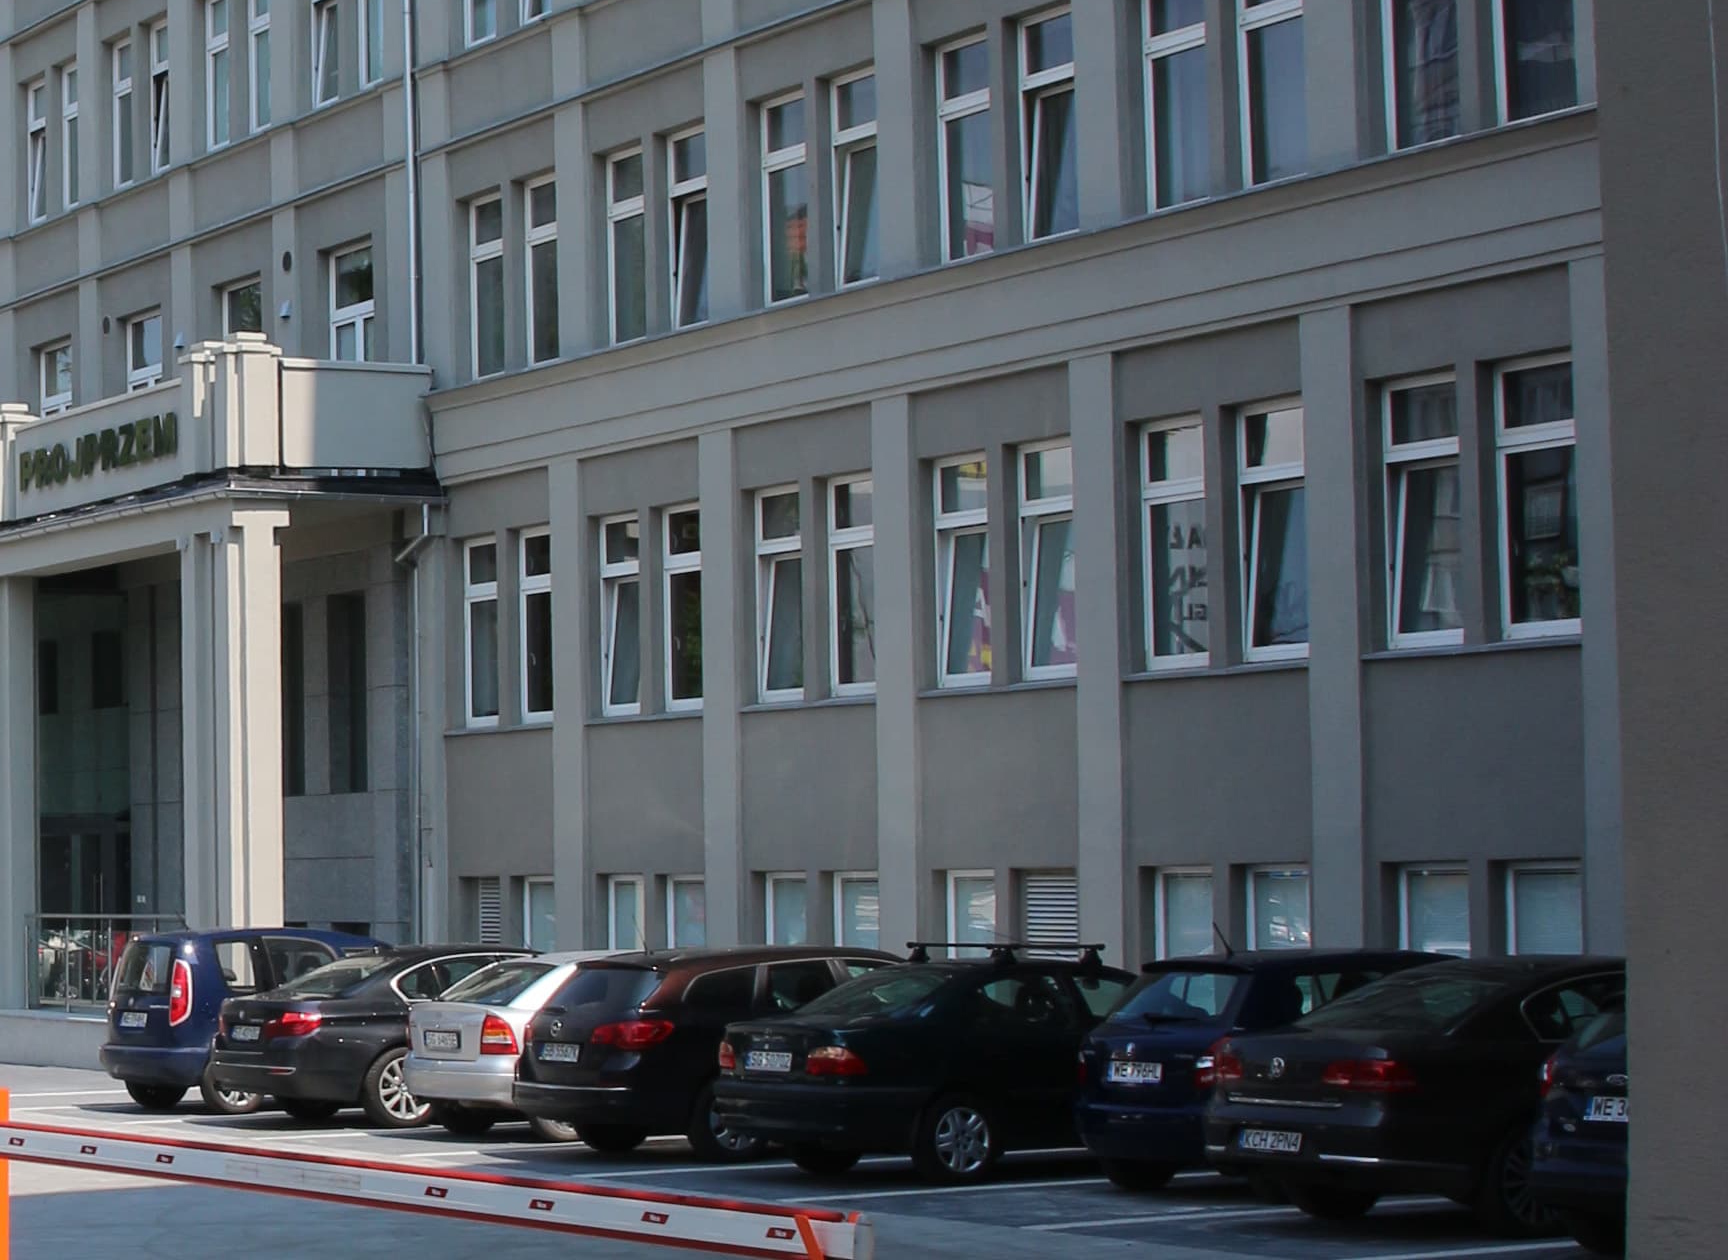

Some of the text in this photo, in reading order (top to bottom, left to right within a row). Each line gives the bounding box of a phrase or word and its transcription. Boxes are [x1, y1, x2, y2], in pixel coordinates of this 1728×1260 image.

[20, 411, 178, 492] PROJPRZEM
[1114, 1062, 1128, 1078] WE
[1593, 1098, 1613, 1116] WE
[1245, 1130, 1269, 1148] KCH
